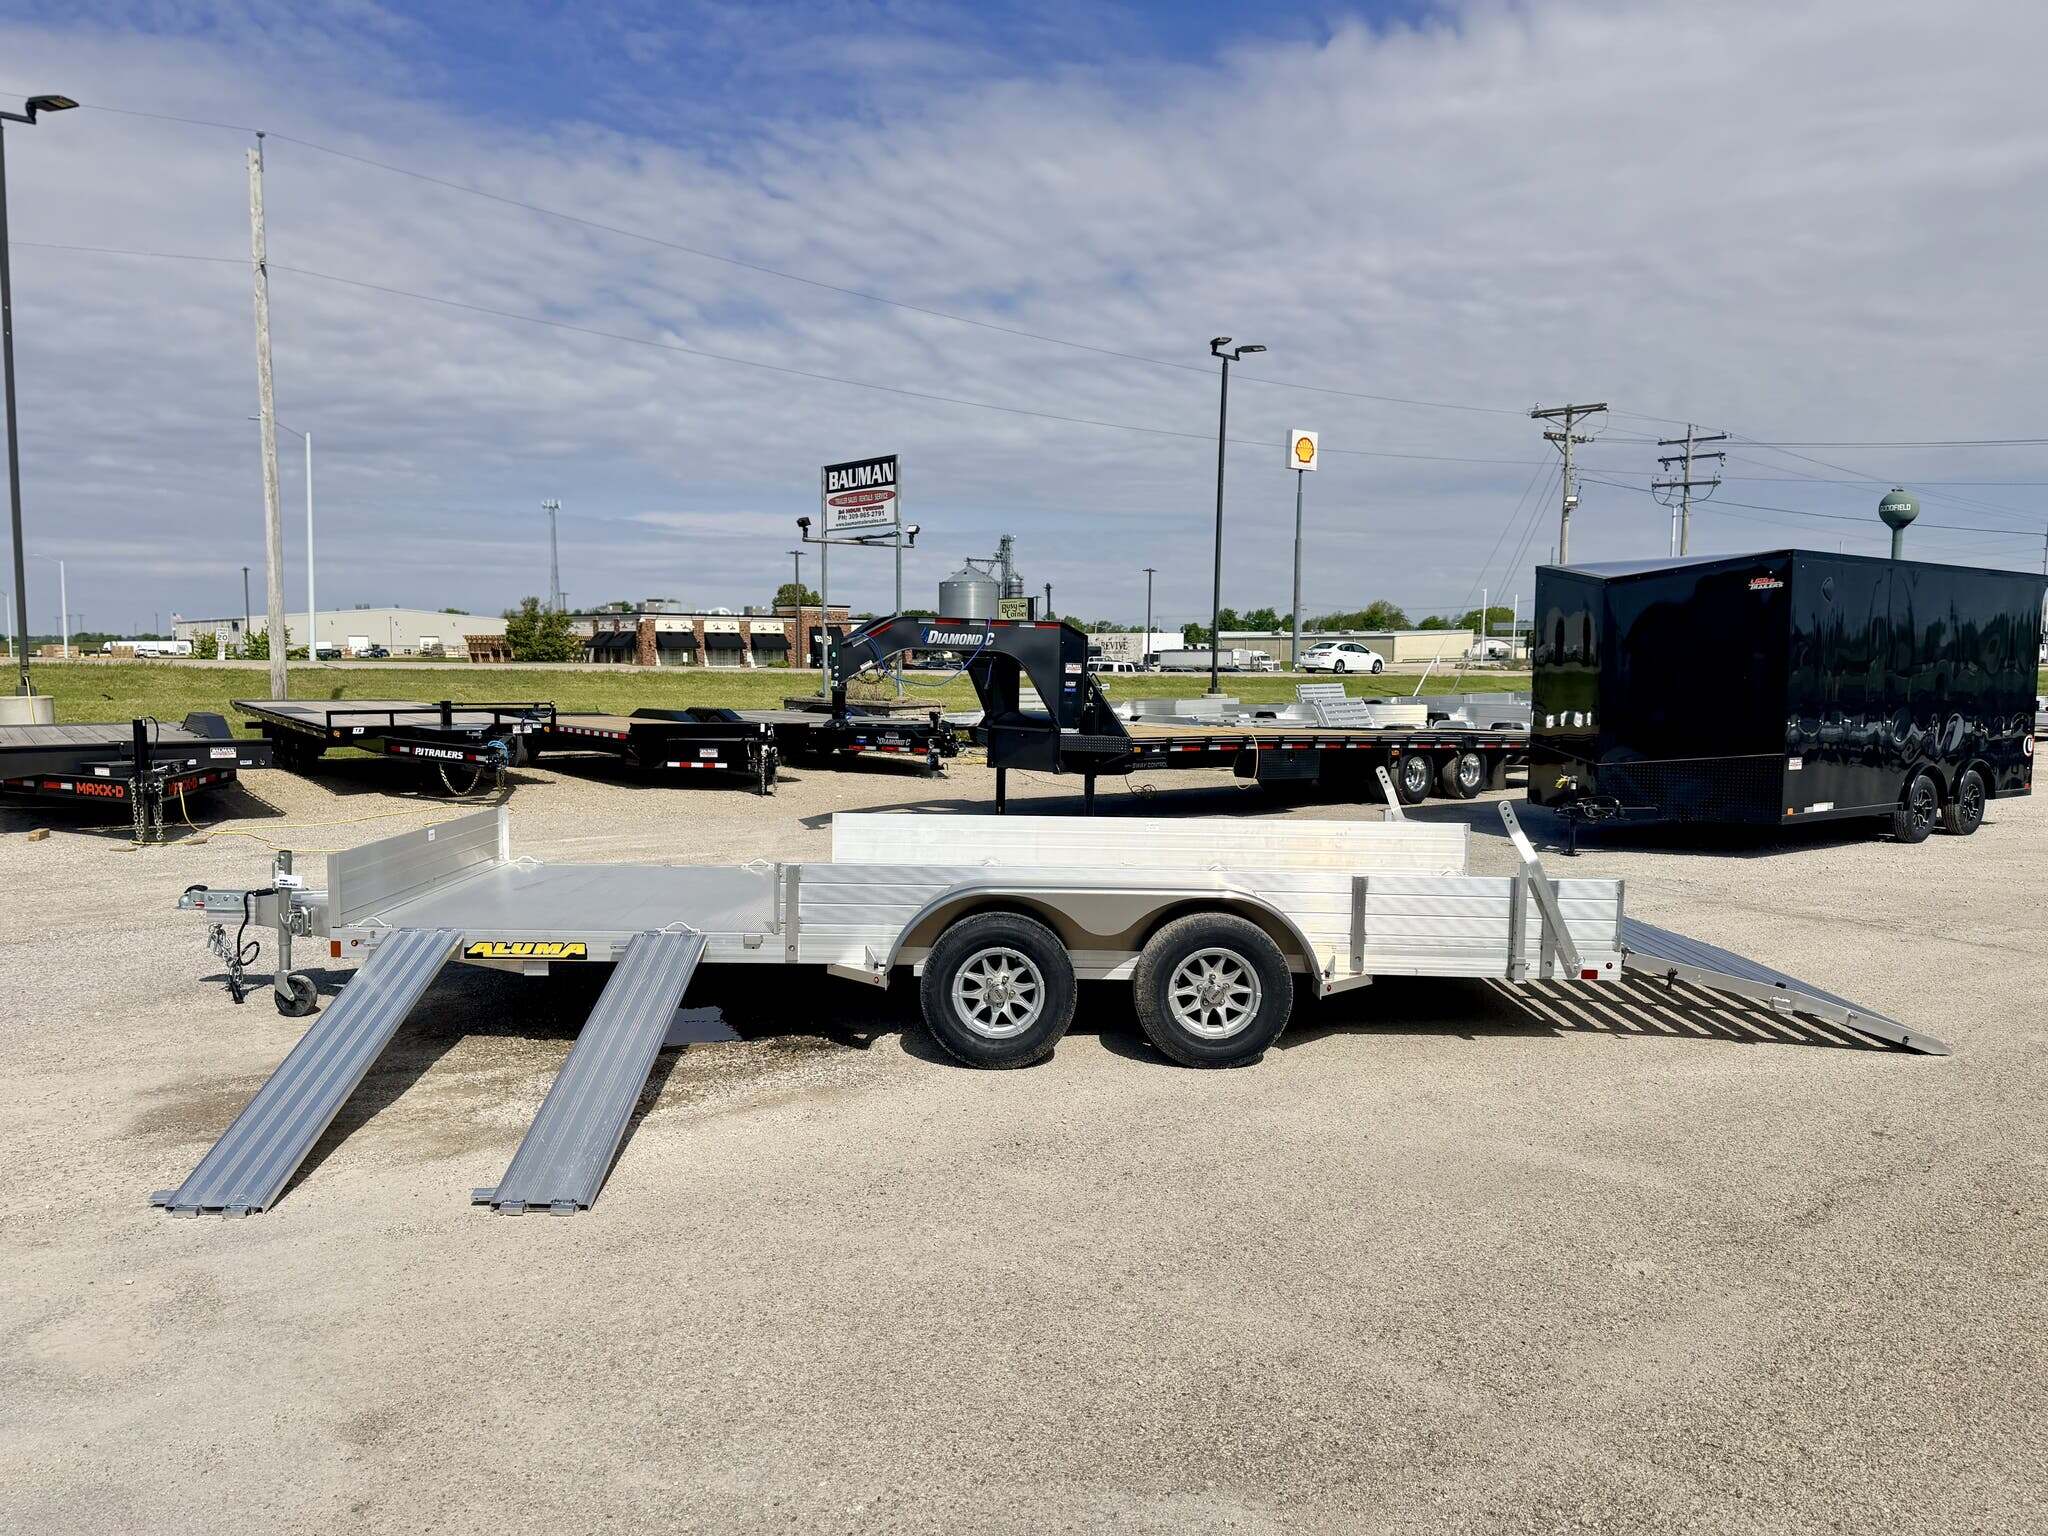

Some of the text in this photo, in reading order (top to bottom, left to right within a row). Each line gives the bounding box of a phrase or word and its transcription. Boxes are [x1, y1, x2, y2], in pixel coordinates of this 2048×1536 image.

[828, 462, 894, 491] BAUMAN
[1001, 603, 1018, 613] Busy
[1006, 609, 1027, 618] Corner
[927, 630, 995, 646] DIAMOND C
[415, 747, 464, 760] PJ TRAILERS
[466, 942, 586, 958] ALUMA
